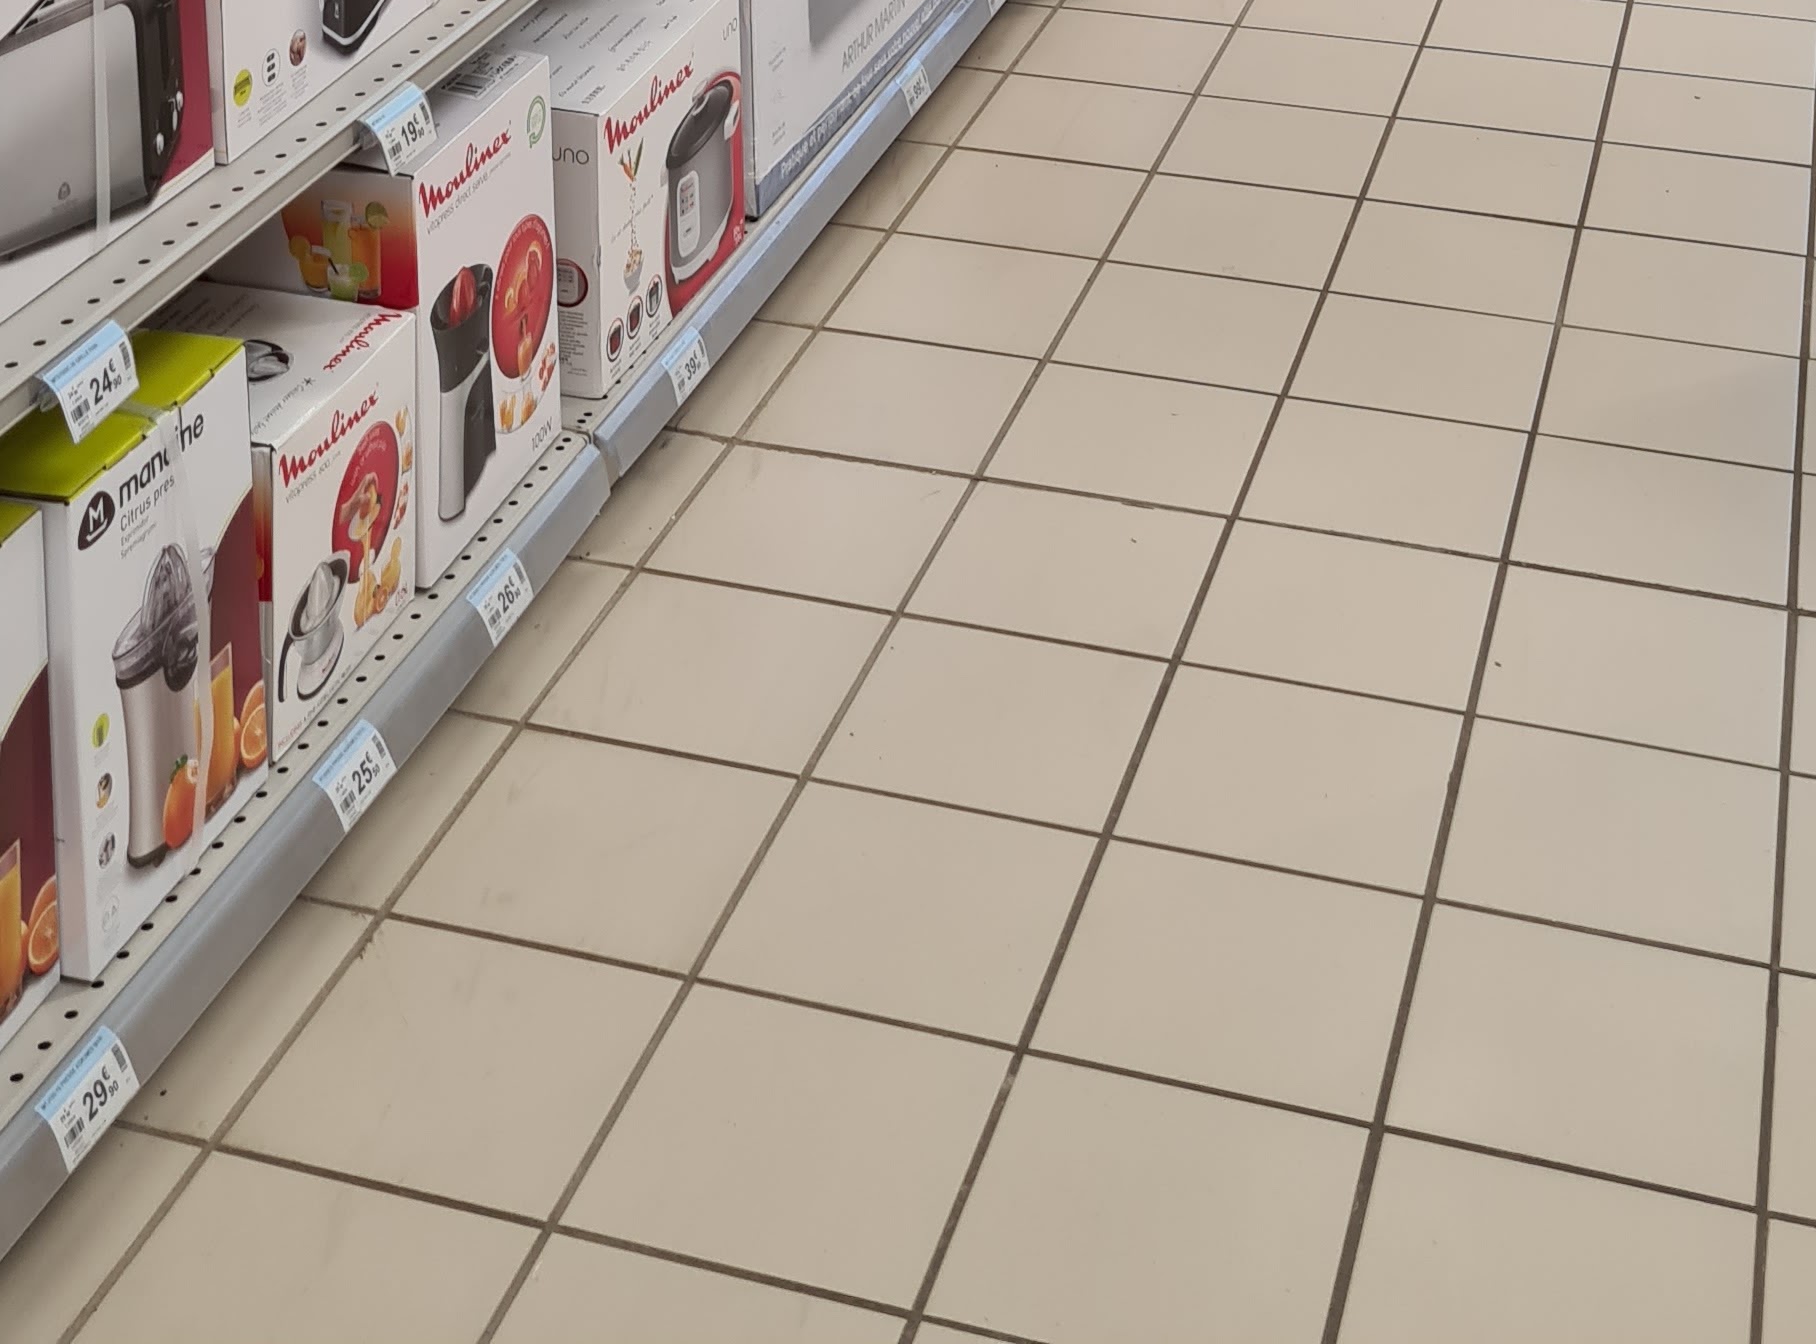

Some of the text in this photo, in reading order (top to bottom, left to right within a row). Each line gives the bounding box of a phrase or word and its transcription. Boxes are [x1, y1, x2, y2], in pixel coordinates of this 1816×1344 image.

[841, 23, 875, 73] ARTHUR
[604, 60, 694, 155] Moulinex
[418, 128, 512, 219] Moulinex
[323, 312, 402, 373] Moulinex
[278, 389, 380, 489] Moulinex
[530, 416, 554, 452] 100W
[120, 499, 151, 533] Citrus
